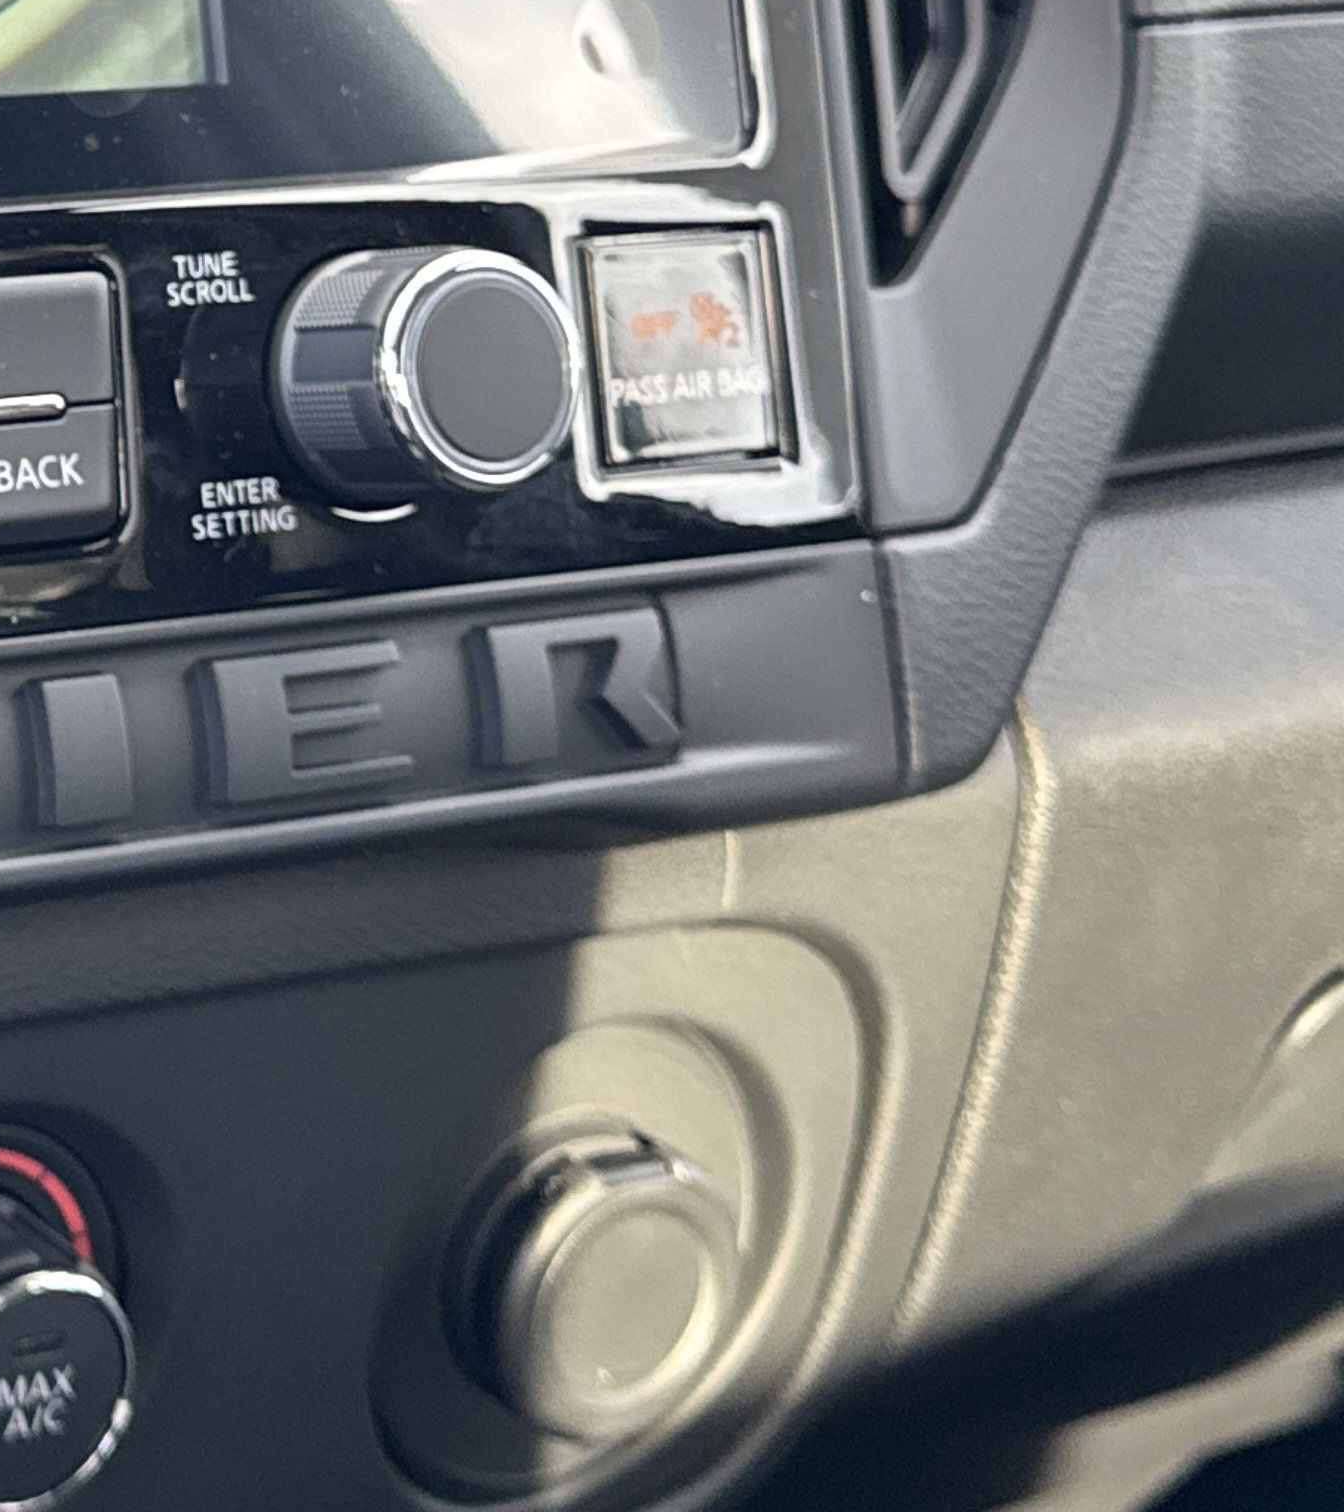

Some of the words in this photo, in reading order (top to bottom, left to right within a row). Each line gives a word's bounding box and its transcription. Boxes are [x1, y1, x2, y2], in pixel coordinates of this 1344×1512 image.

[172, 251, 238, 279] TUNE
[167, 278, 255, 307] SCROLL
[611, 373, 668, 407] PASS
[672, 368, 712, 402] AIR
[199, 475, 280, 509] ENTER
[190, 504, 298, 541] SETTING
[3, 1397, 65, 1442] A/C
